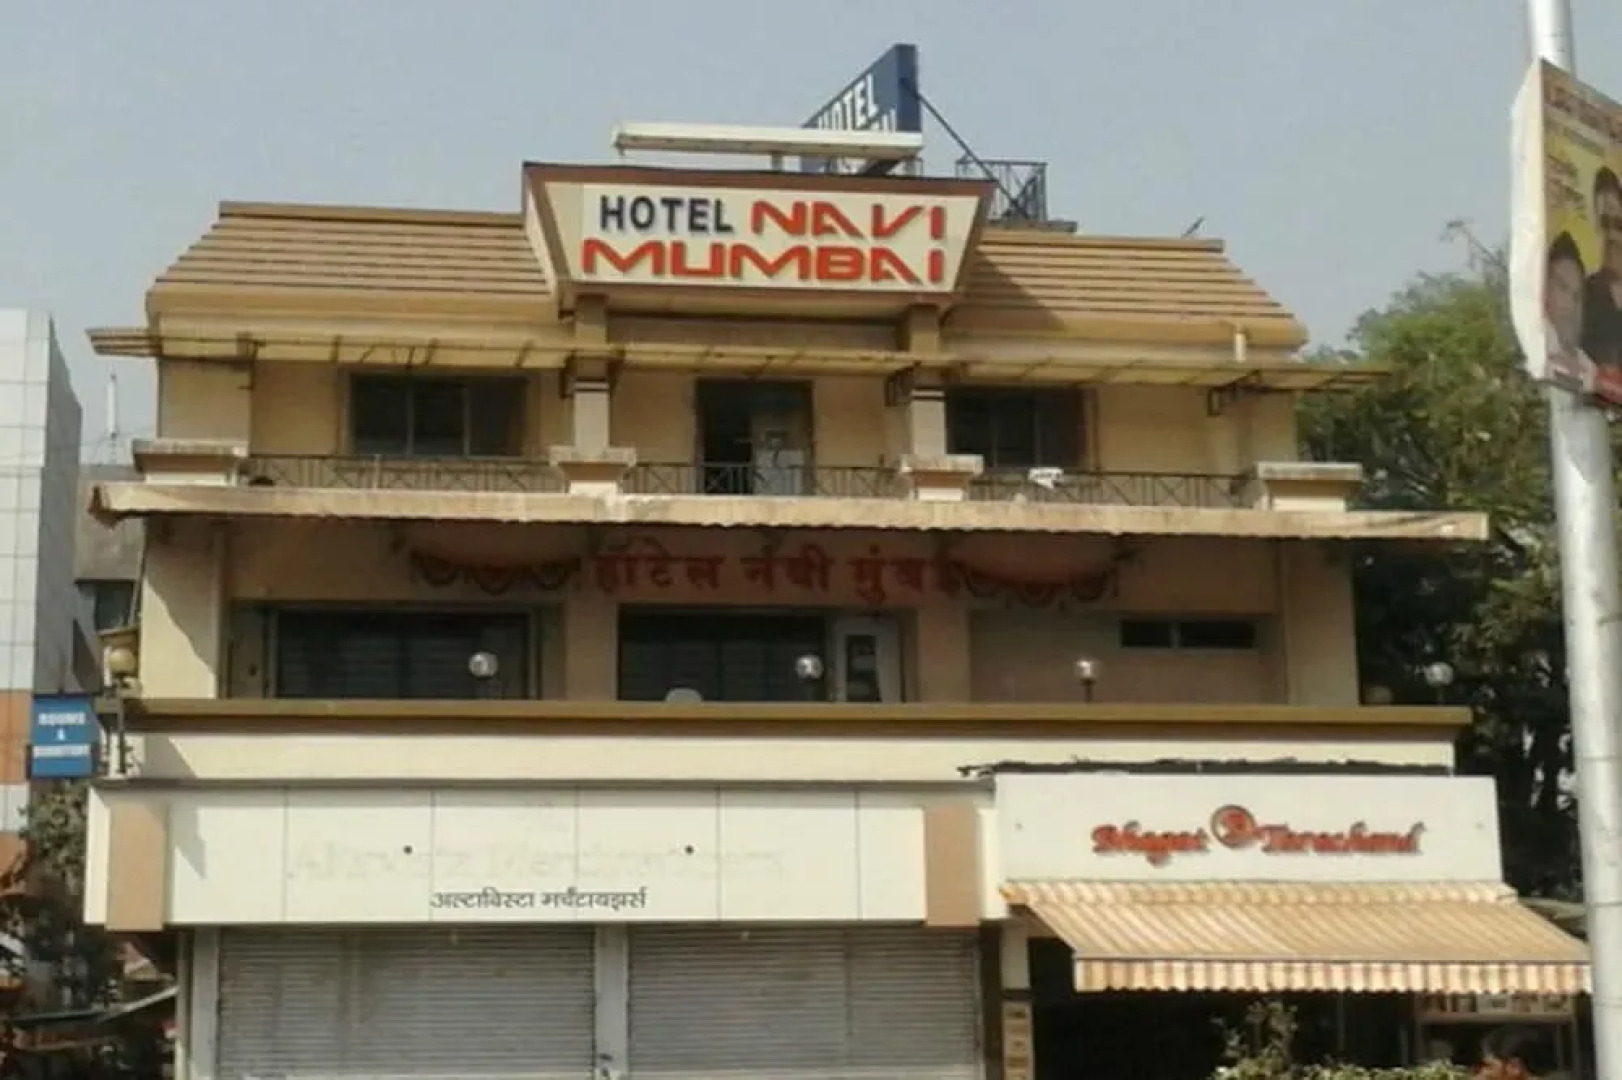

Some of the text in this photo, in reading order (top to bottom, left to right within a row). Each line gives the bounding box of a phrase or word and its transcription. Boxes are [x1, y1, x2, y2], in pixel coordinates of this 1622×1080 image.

[601, 194, 945, 241] HOTEL NAVI
[581, 239, 945, 284] MUMBAI
